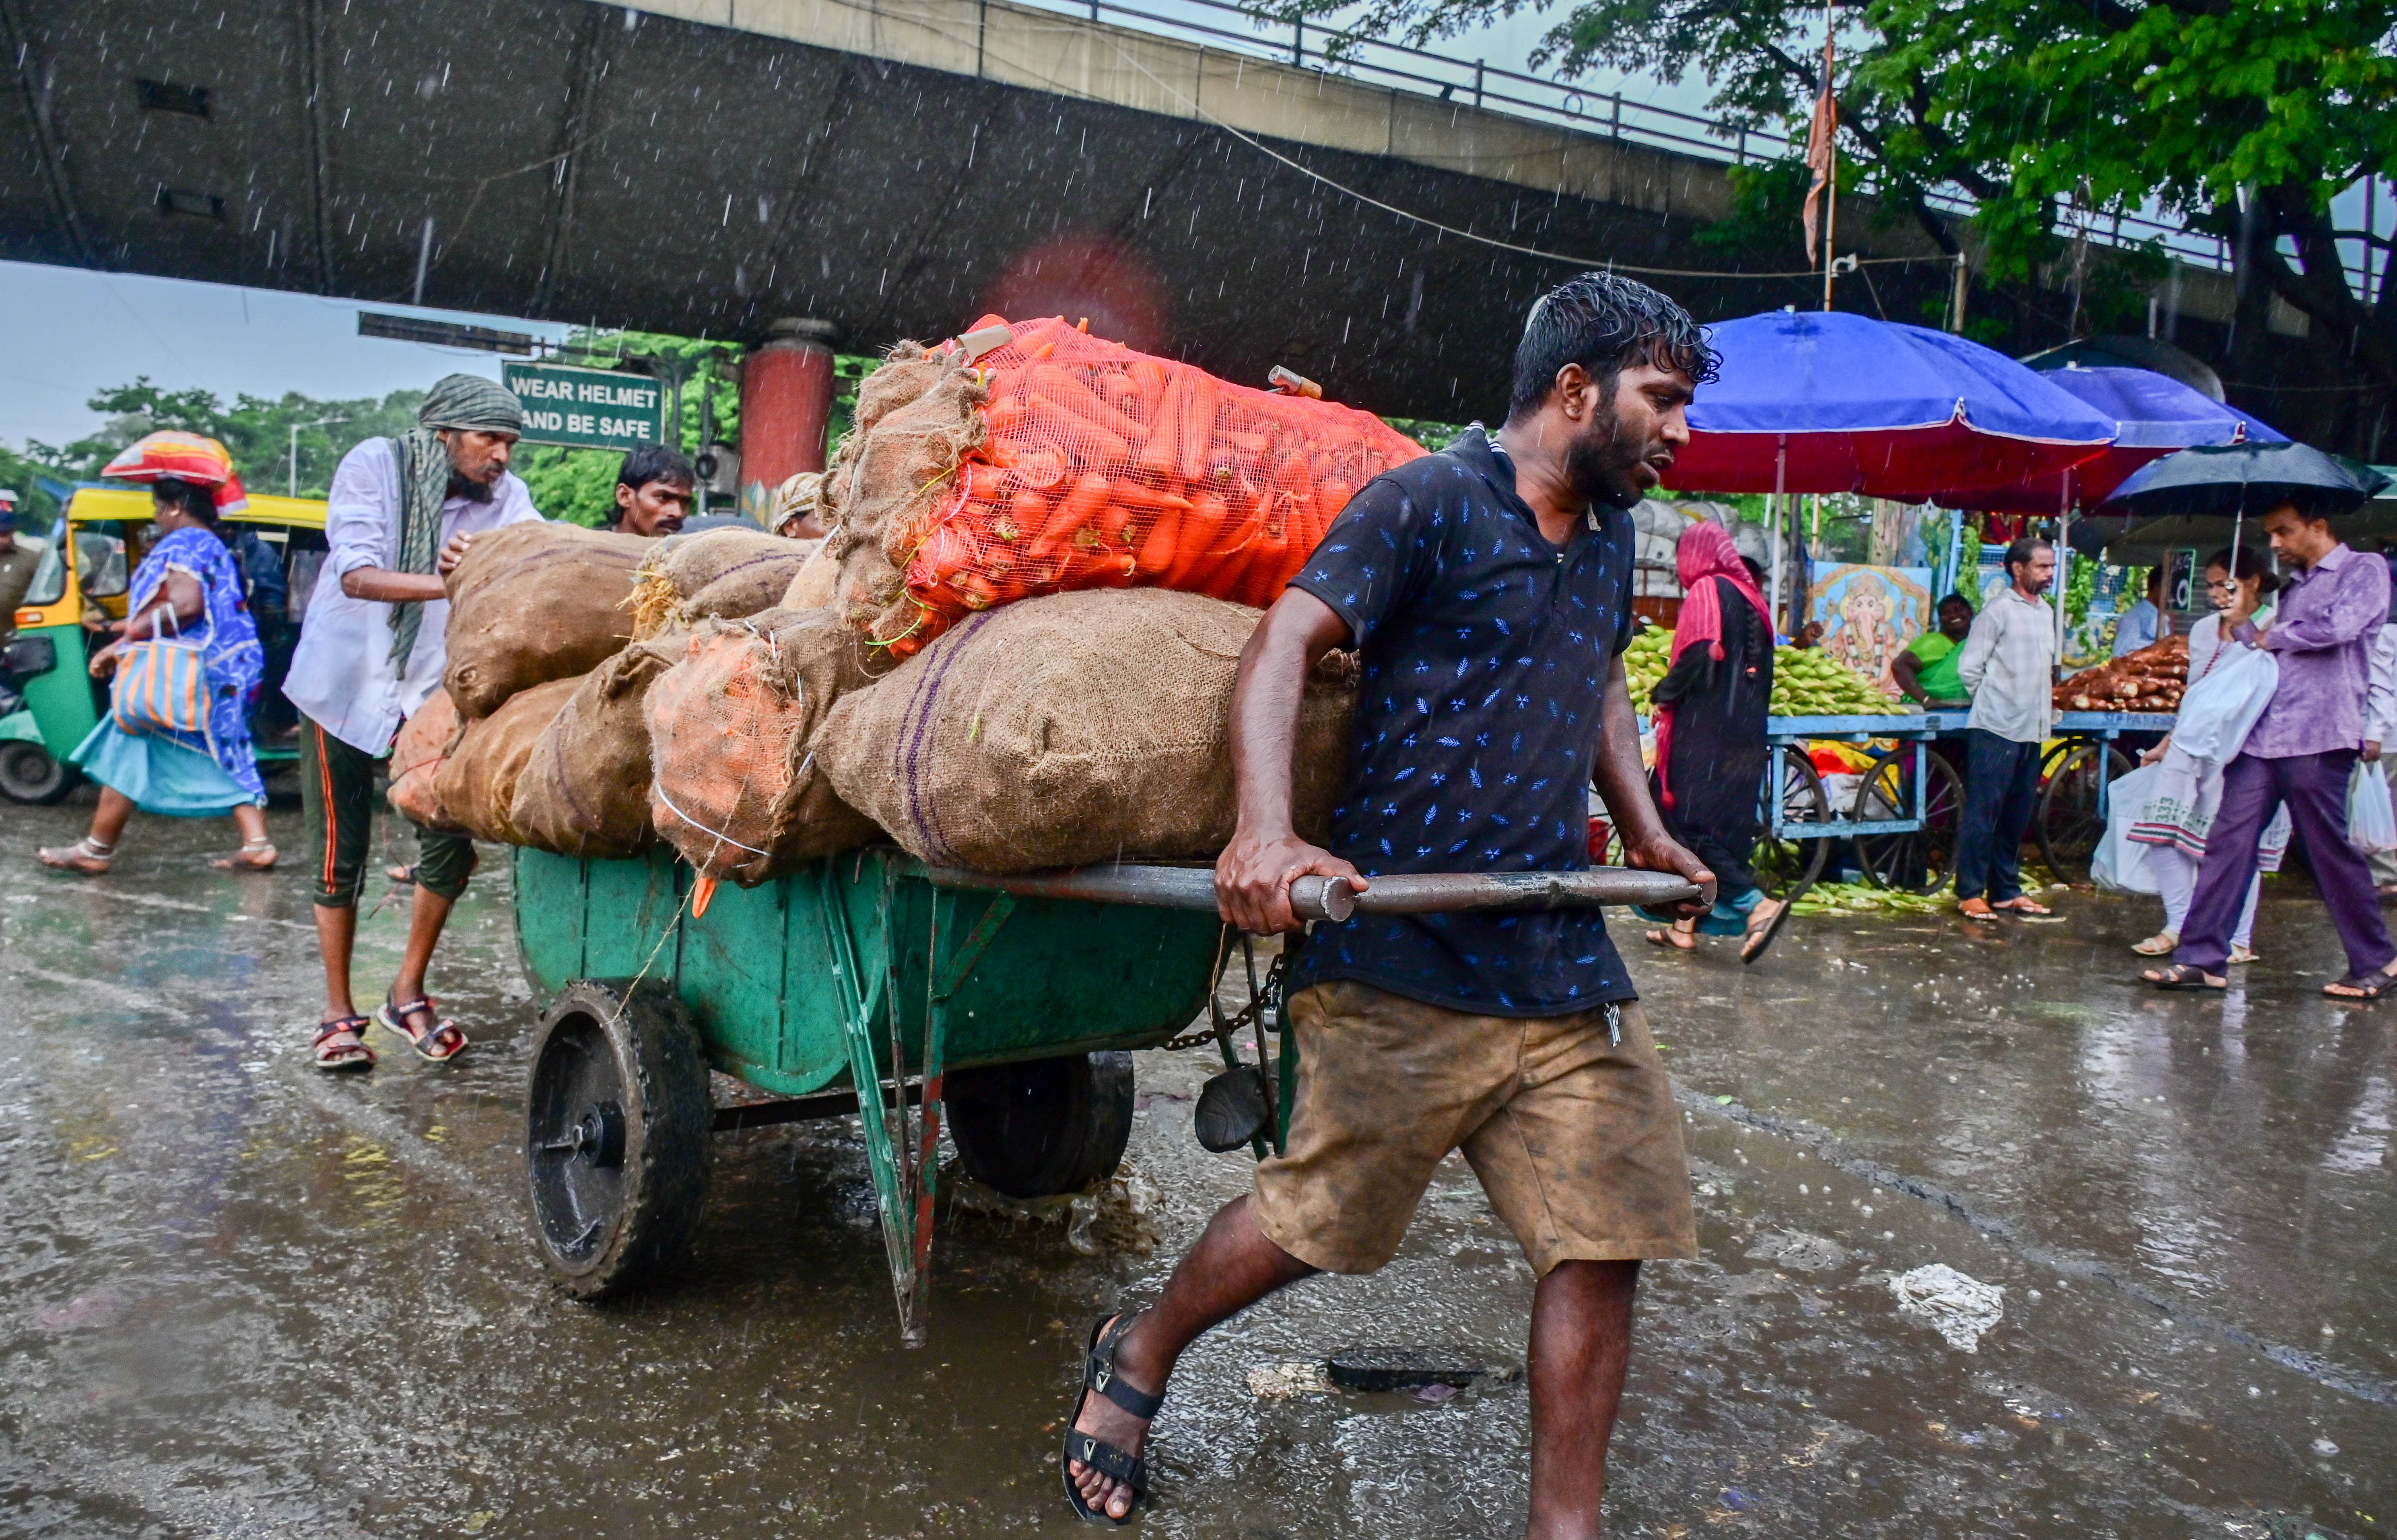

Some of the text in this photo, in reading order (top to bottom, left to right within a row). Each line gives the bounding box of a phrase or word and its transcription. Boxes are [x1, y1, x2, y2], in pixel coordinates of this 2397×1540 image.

[511, 377, 657, 408] WEAR HELMET
[521, 410, 651, 439] AND BE SAFE
